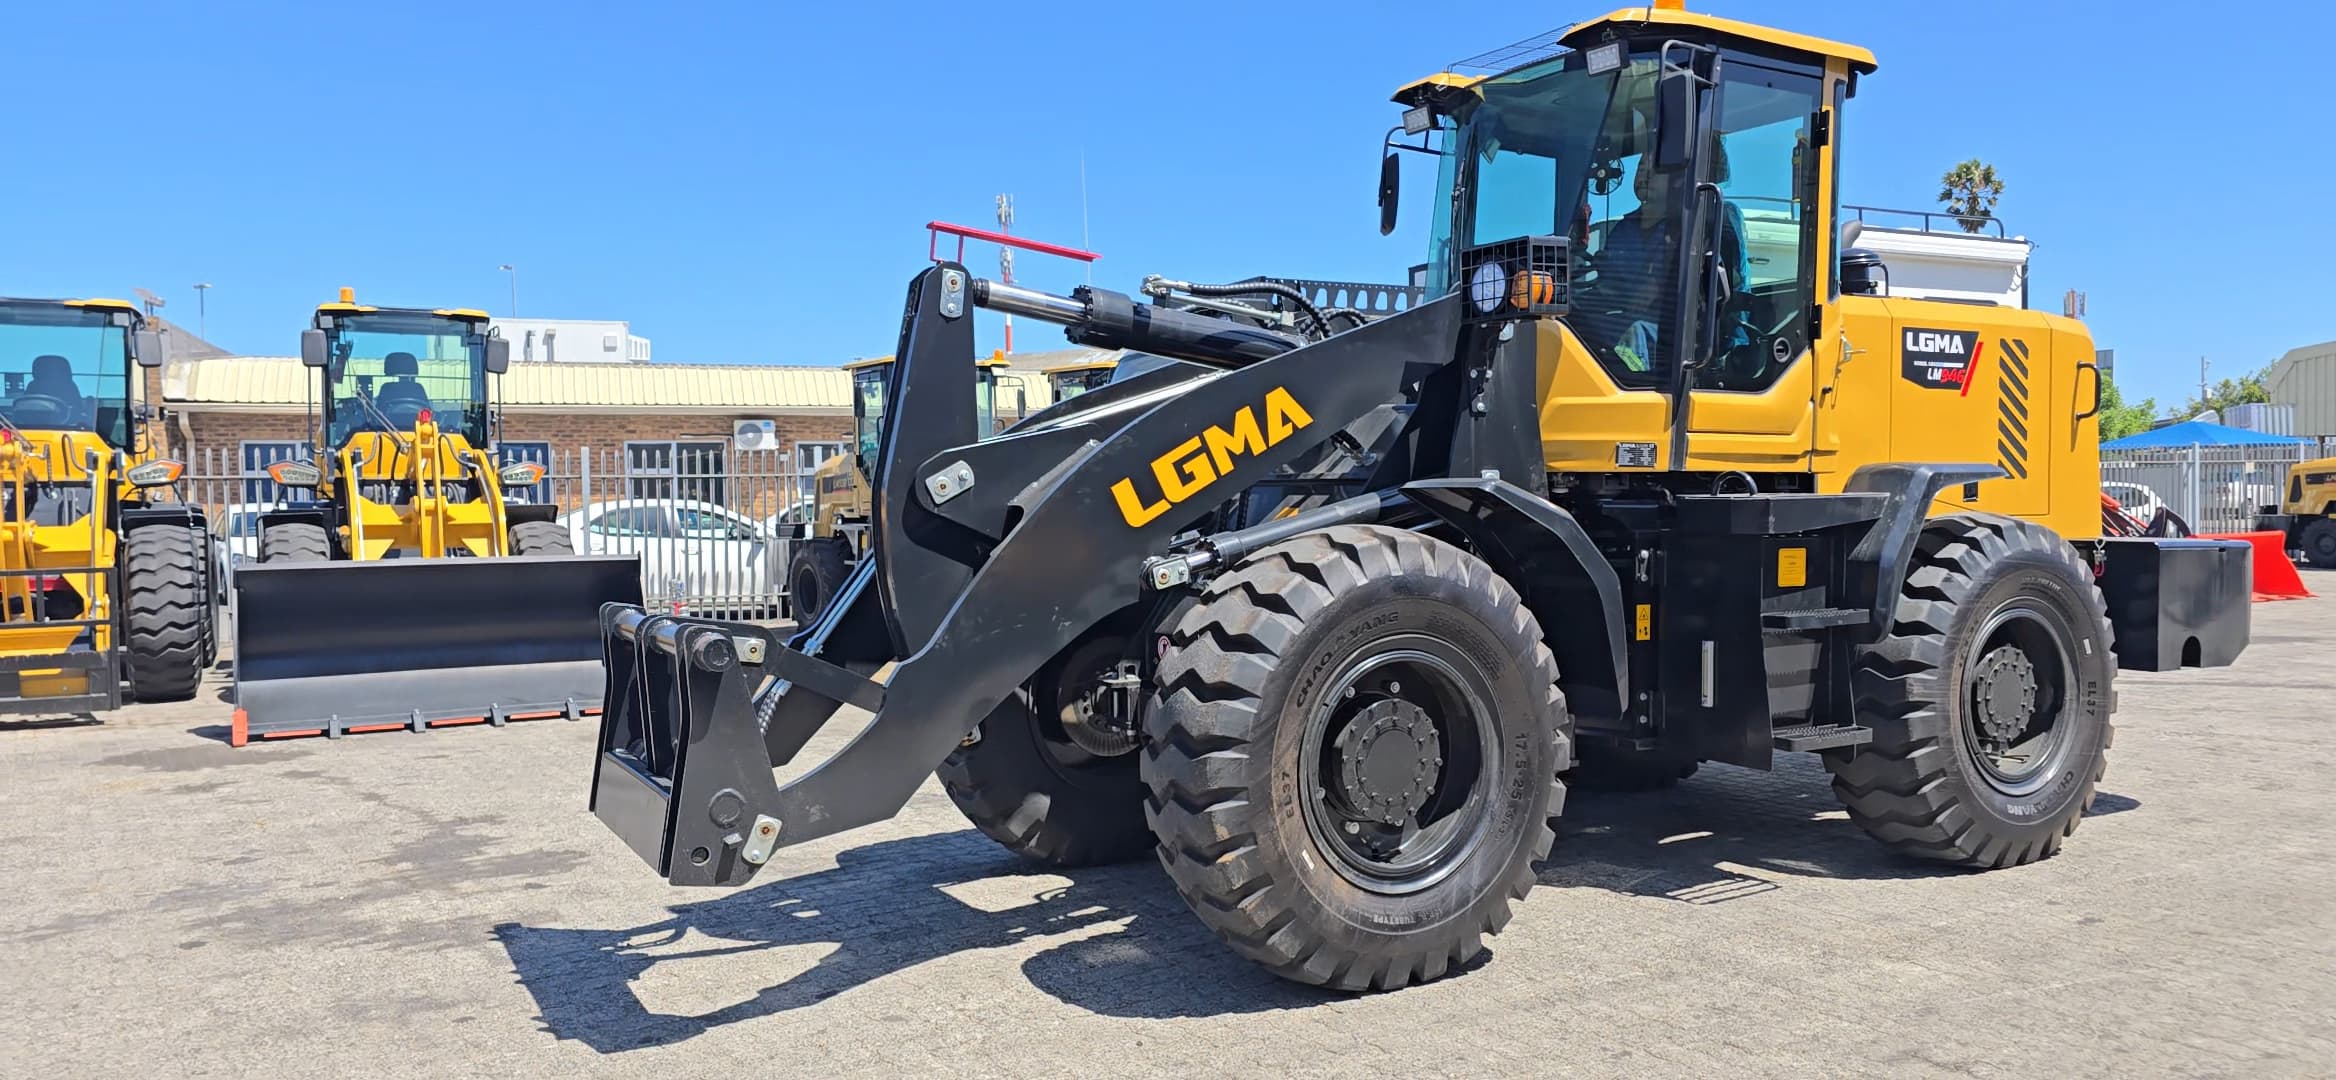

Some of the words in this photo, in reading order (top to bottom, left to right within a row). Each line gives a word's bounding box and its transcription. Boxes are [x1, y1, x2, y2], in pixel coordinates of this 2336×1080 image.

[1906, 331, 1965, 354] LGMA
[1110, 385, 1314, 528] LGMA
[2086, 681, 2097, 717] EL37
[1281, 771, 1294, 818] EL37
